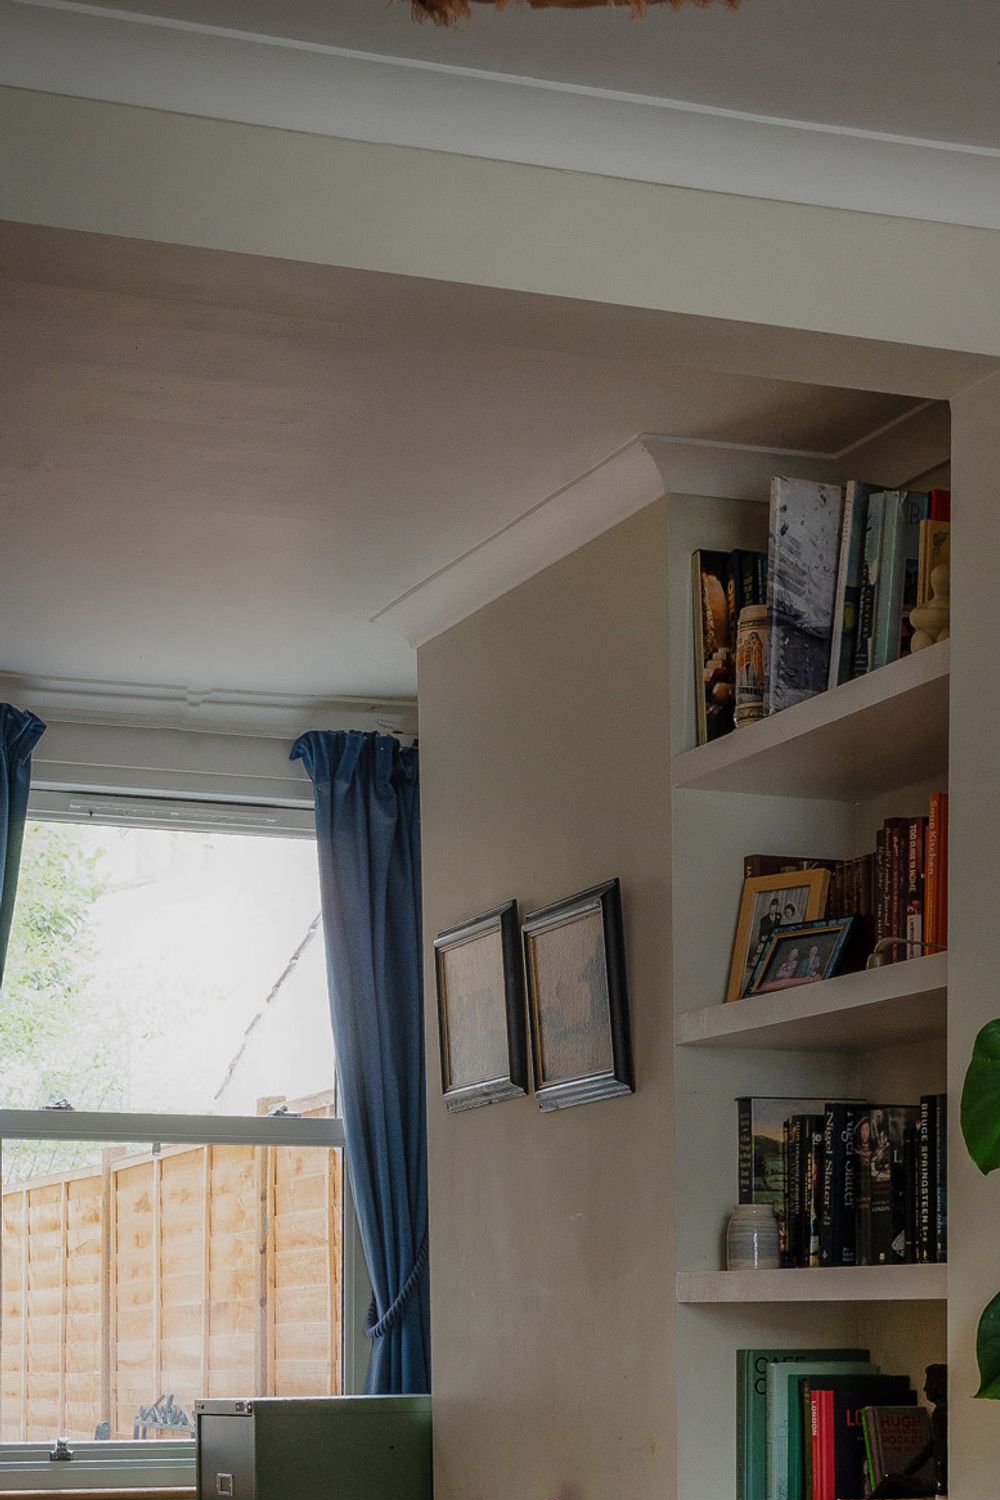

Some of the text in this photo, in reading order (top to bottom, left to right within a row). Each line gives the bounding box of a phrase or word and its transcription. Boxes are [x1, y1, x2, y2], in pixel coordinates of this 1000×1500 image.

[909, 824, 917, 841] TOO
[927, 800, 938, 829] Soup
[927, 831, 937, 875] Kitchen
[908, 869, 917, 893] HOME
[824, 1111, 834, 1155] Nigel
[841, 1112, 856, 1157] Nigel
[921, 1103, 929, 1223] BRUCE SPRINGSTEEN
[823, 1159, 833, 1208] Slater
[881, 1415, 922, 1428] HUGH
[881, 1435, 924, 1446] POCKET
